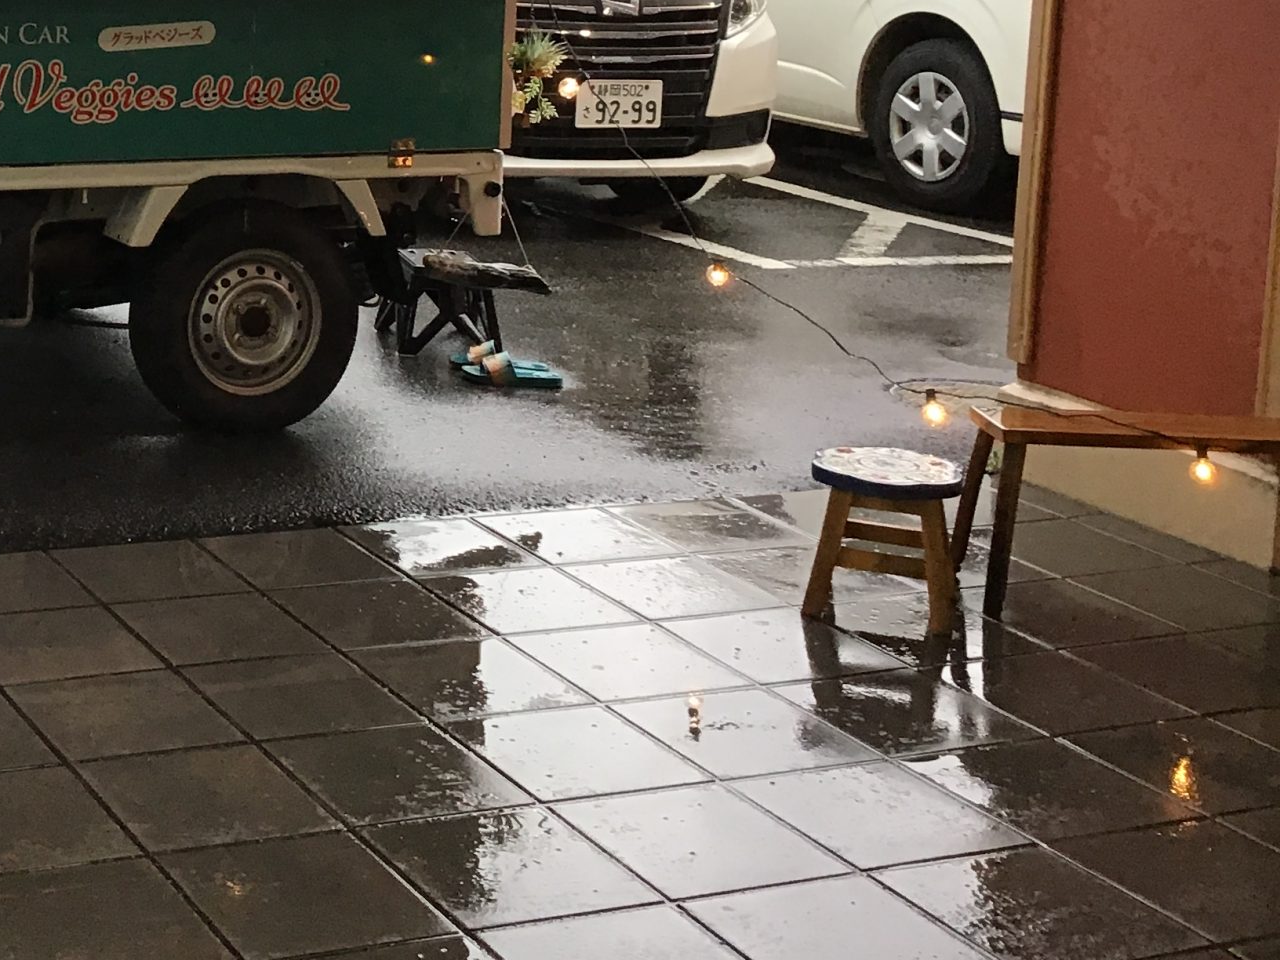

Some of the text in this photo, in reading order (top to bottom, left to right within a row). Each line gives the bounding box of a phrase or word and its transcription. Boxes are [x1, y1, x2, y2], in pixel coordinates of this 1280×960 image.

[18, 22, 71, 46] CAR
[13, 58, 178, 125] Veggies
[594, 100, 657, 125] 92-99
